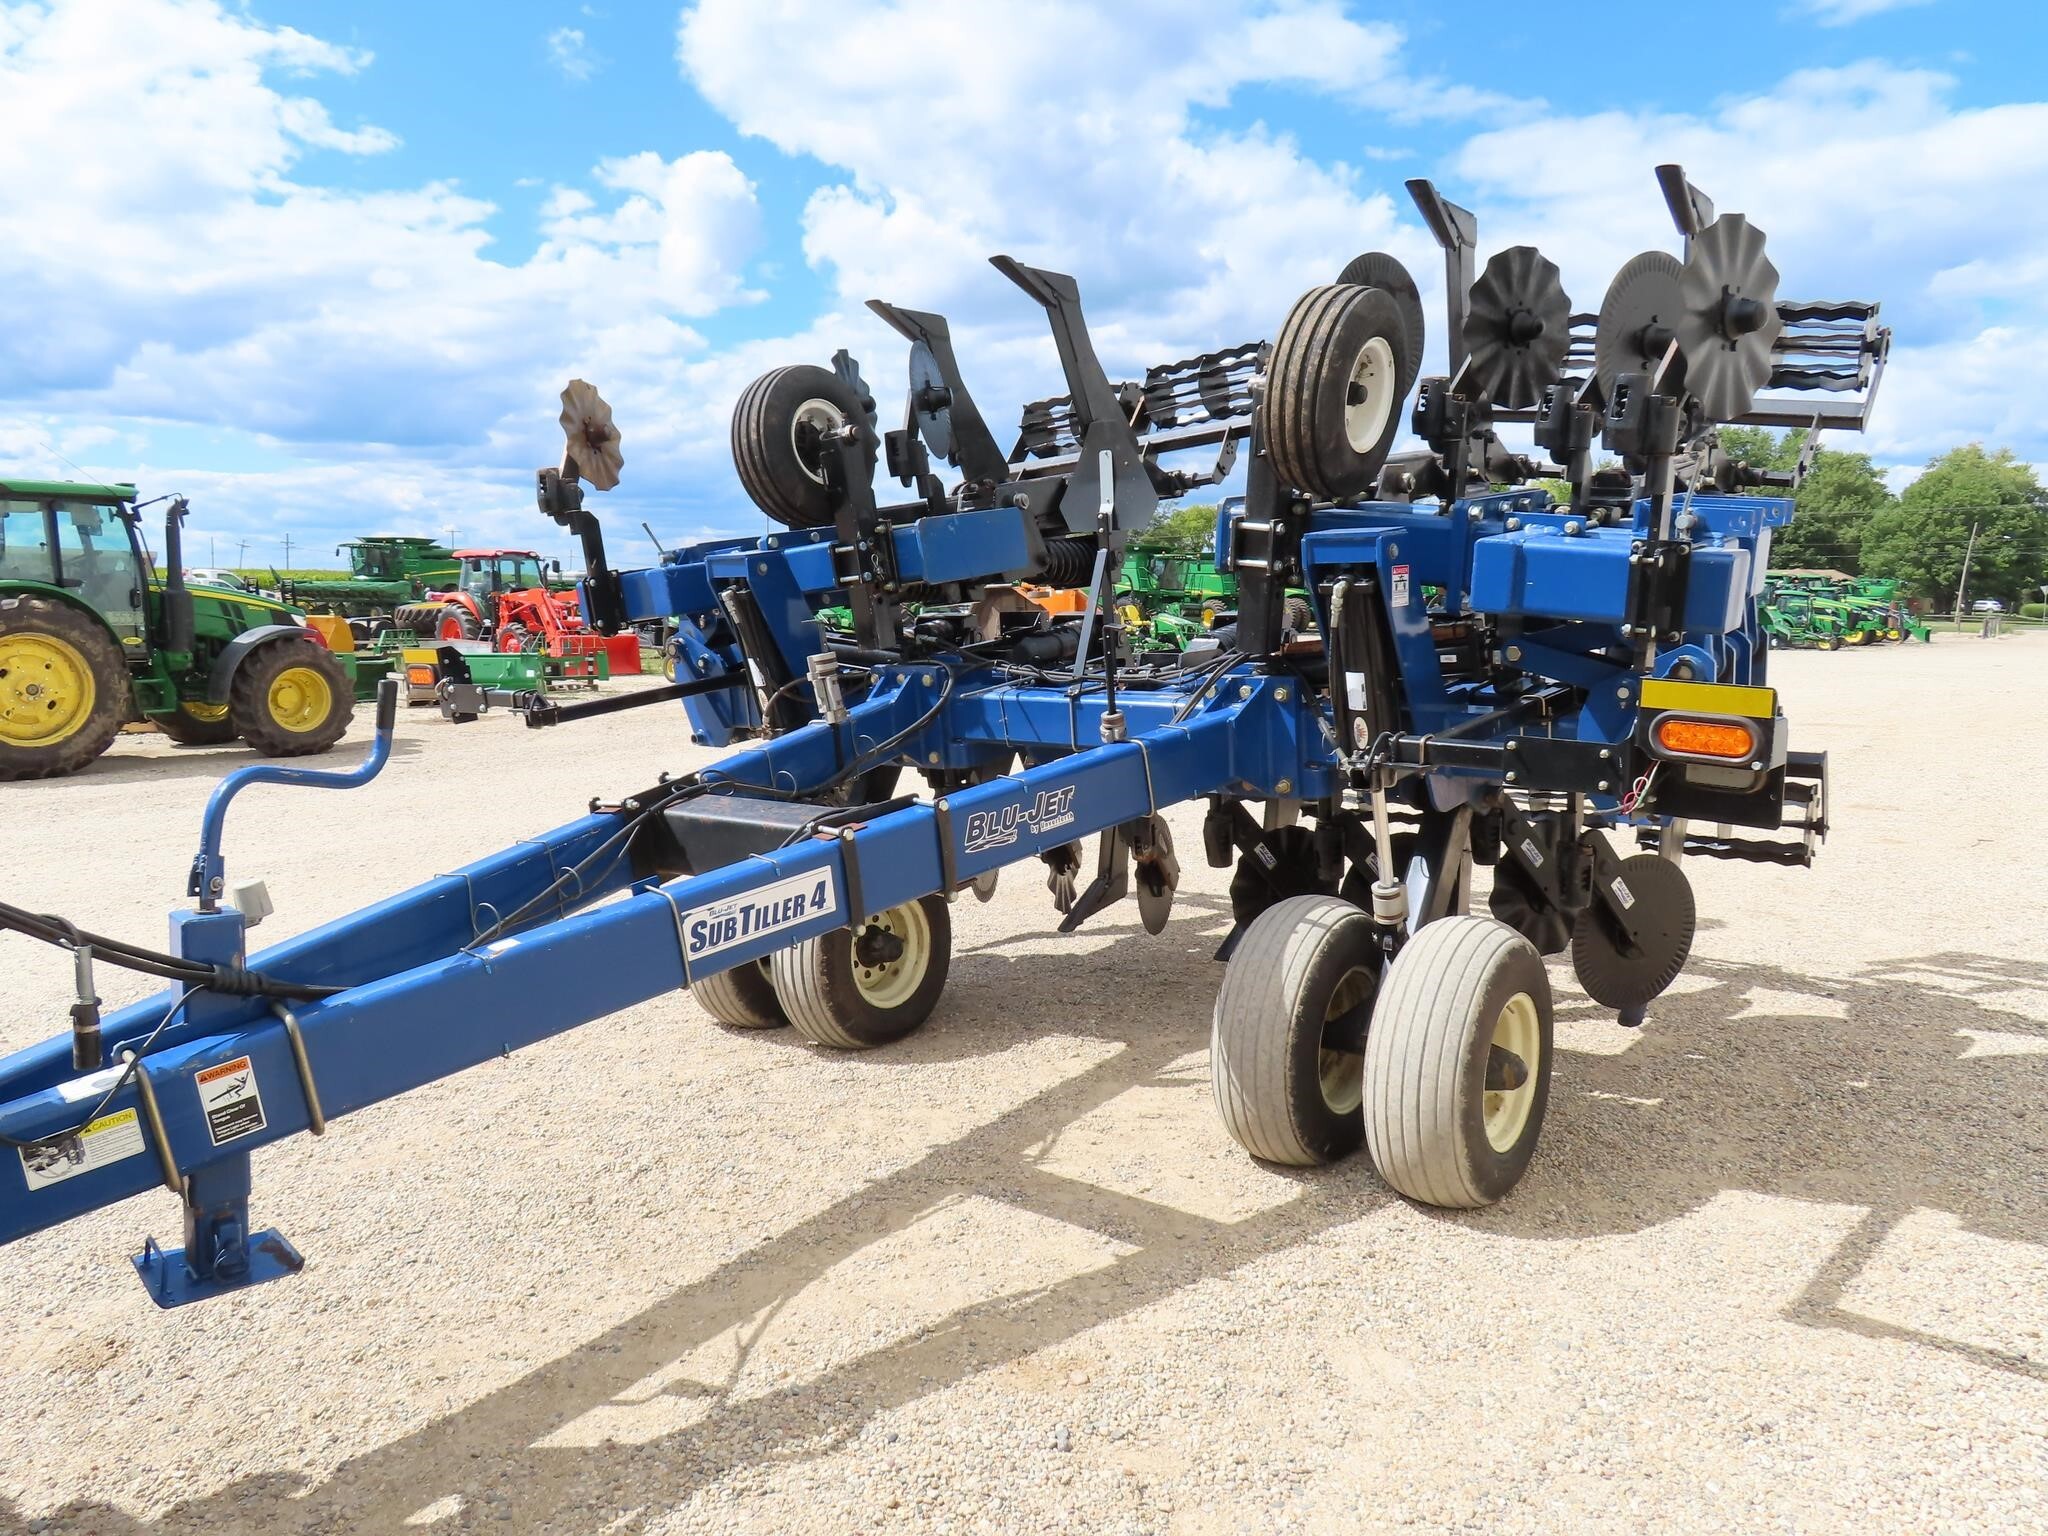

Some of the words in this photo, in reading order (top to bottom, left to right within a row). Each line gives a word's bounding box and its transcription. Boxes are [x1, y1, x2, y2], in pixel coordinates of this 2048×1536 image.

[965, 785, 1075, 846] BLU-JET
[810, 880, 826, 910] 4
[207, 1061, 246, 1079] WARNING
[92, 1112, 132, 1130] CAUTION
